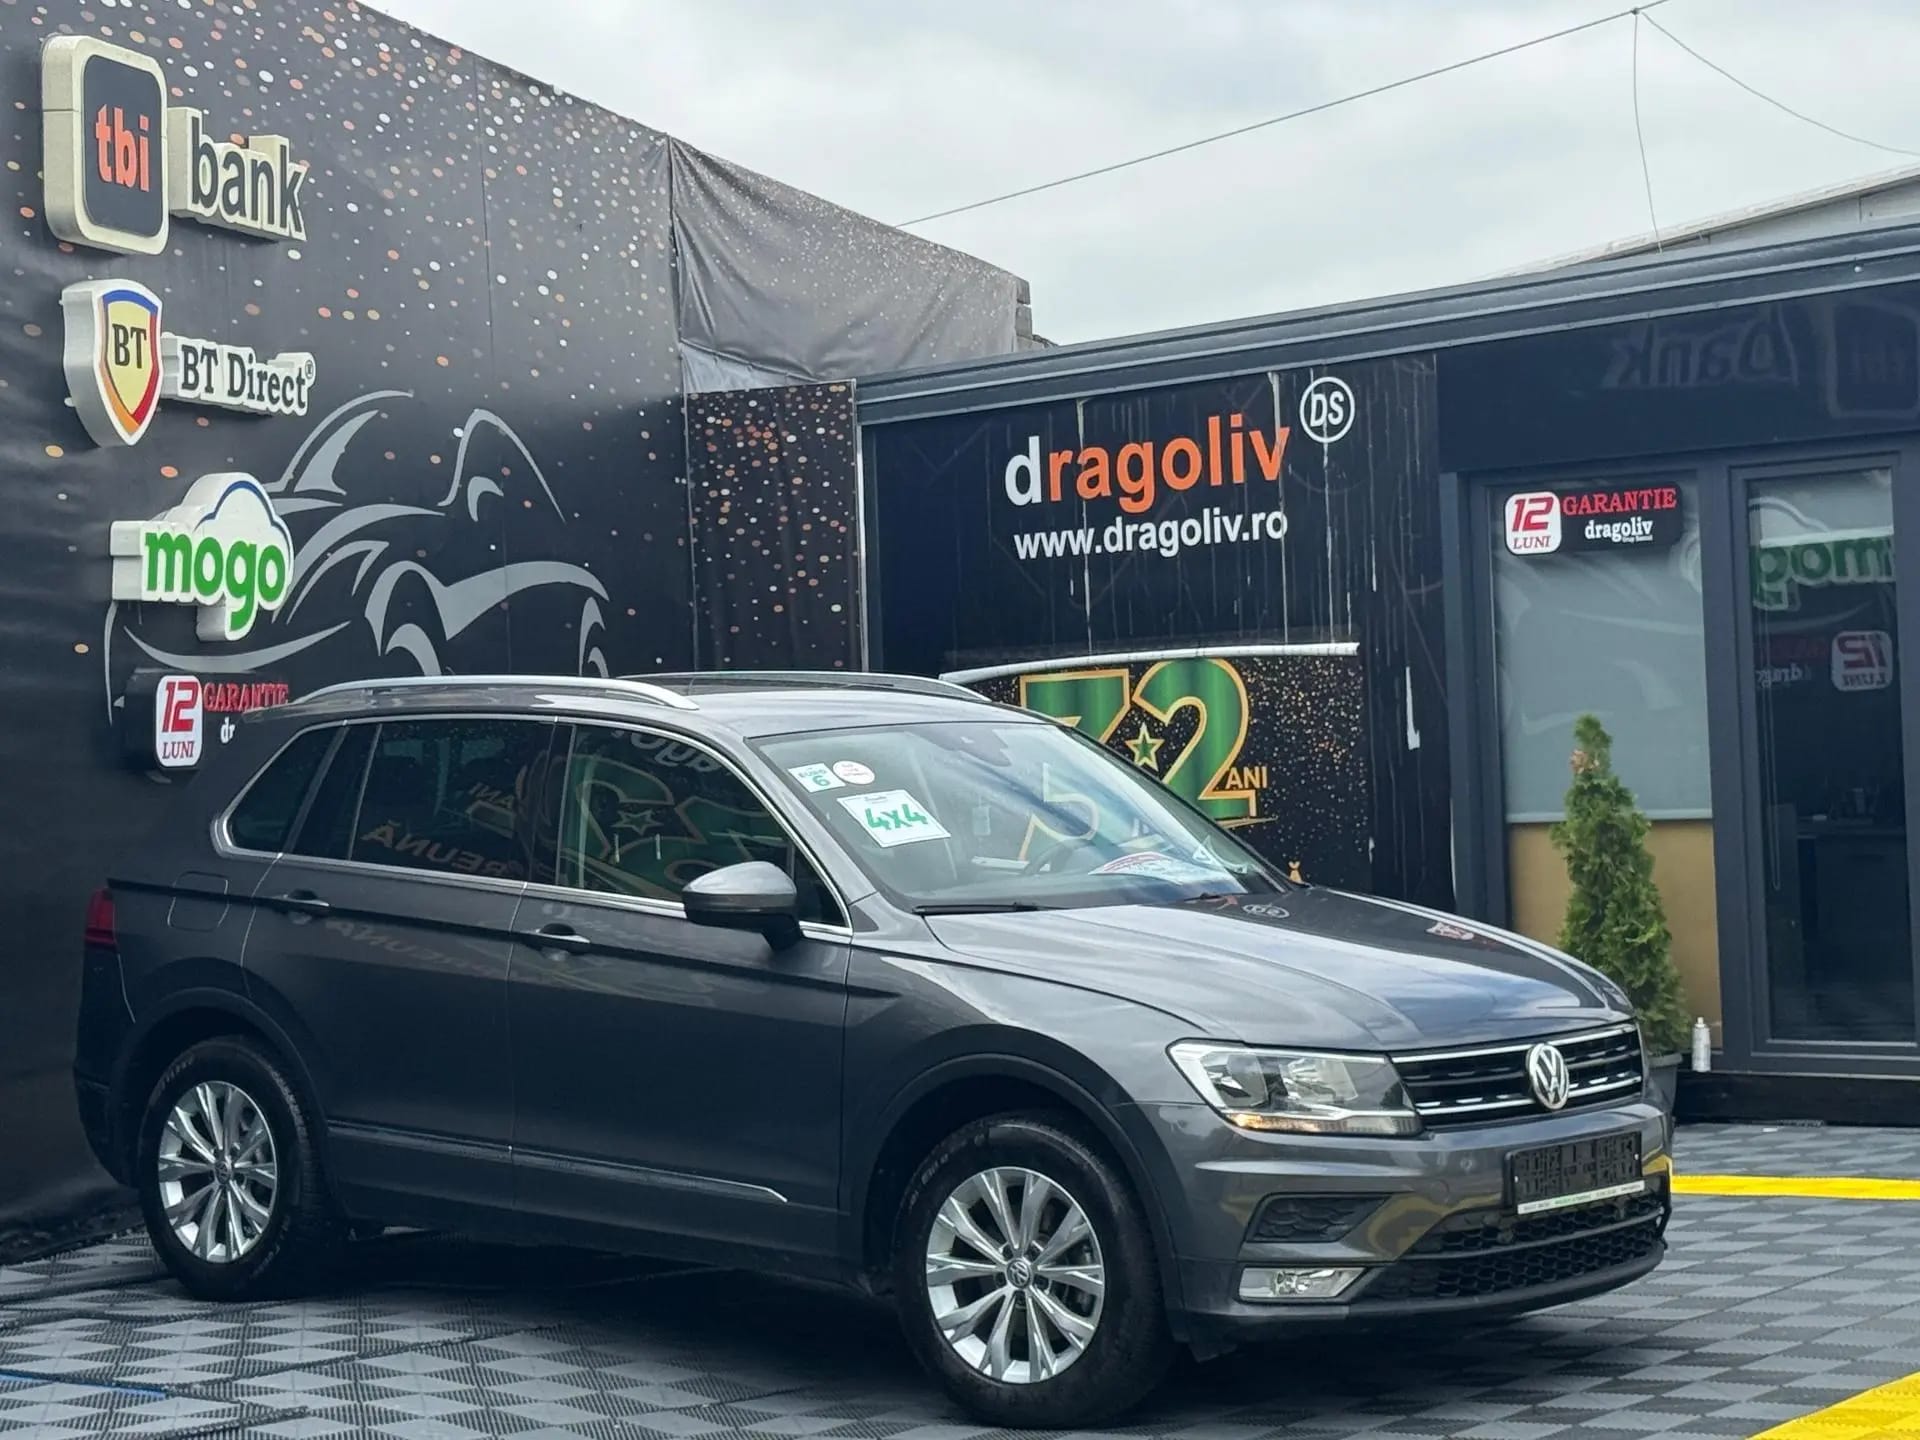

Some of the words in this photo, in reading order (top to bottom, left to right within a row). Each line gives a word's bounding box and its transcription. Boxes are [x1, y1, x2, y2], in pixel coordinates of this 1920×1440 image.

[95, 104, 149, 193] tbi
[191, 116, 304, 234] bank
[111, 323, 147, 370] BT
[181, 344, 218, 395] BT
[1309, 390, 1345, 428] DS
[1004, 412, 1291, 514] dragoliv
[1511, 496, 1554, 533] 12
[1562, 487, 1677, 517] GARANTIE
[1013, 507, 1289, 558] www.dragoliv.ro
[1512, 535, 1552, 550] LUNI
[1584, 516, 1654, 543] dragoliv
[145, 531, 287, 633] mogo
[161, 680, 199, 733] 12
[203, 681, 290, 712] GARANTIE
[161, 740, 195, 760] LUNI
[811, 774, 831, 787] 6
[1225, 765, 1268, 790] ANI
